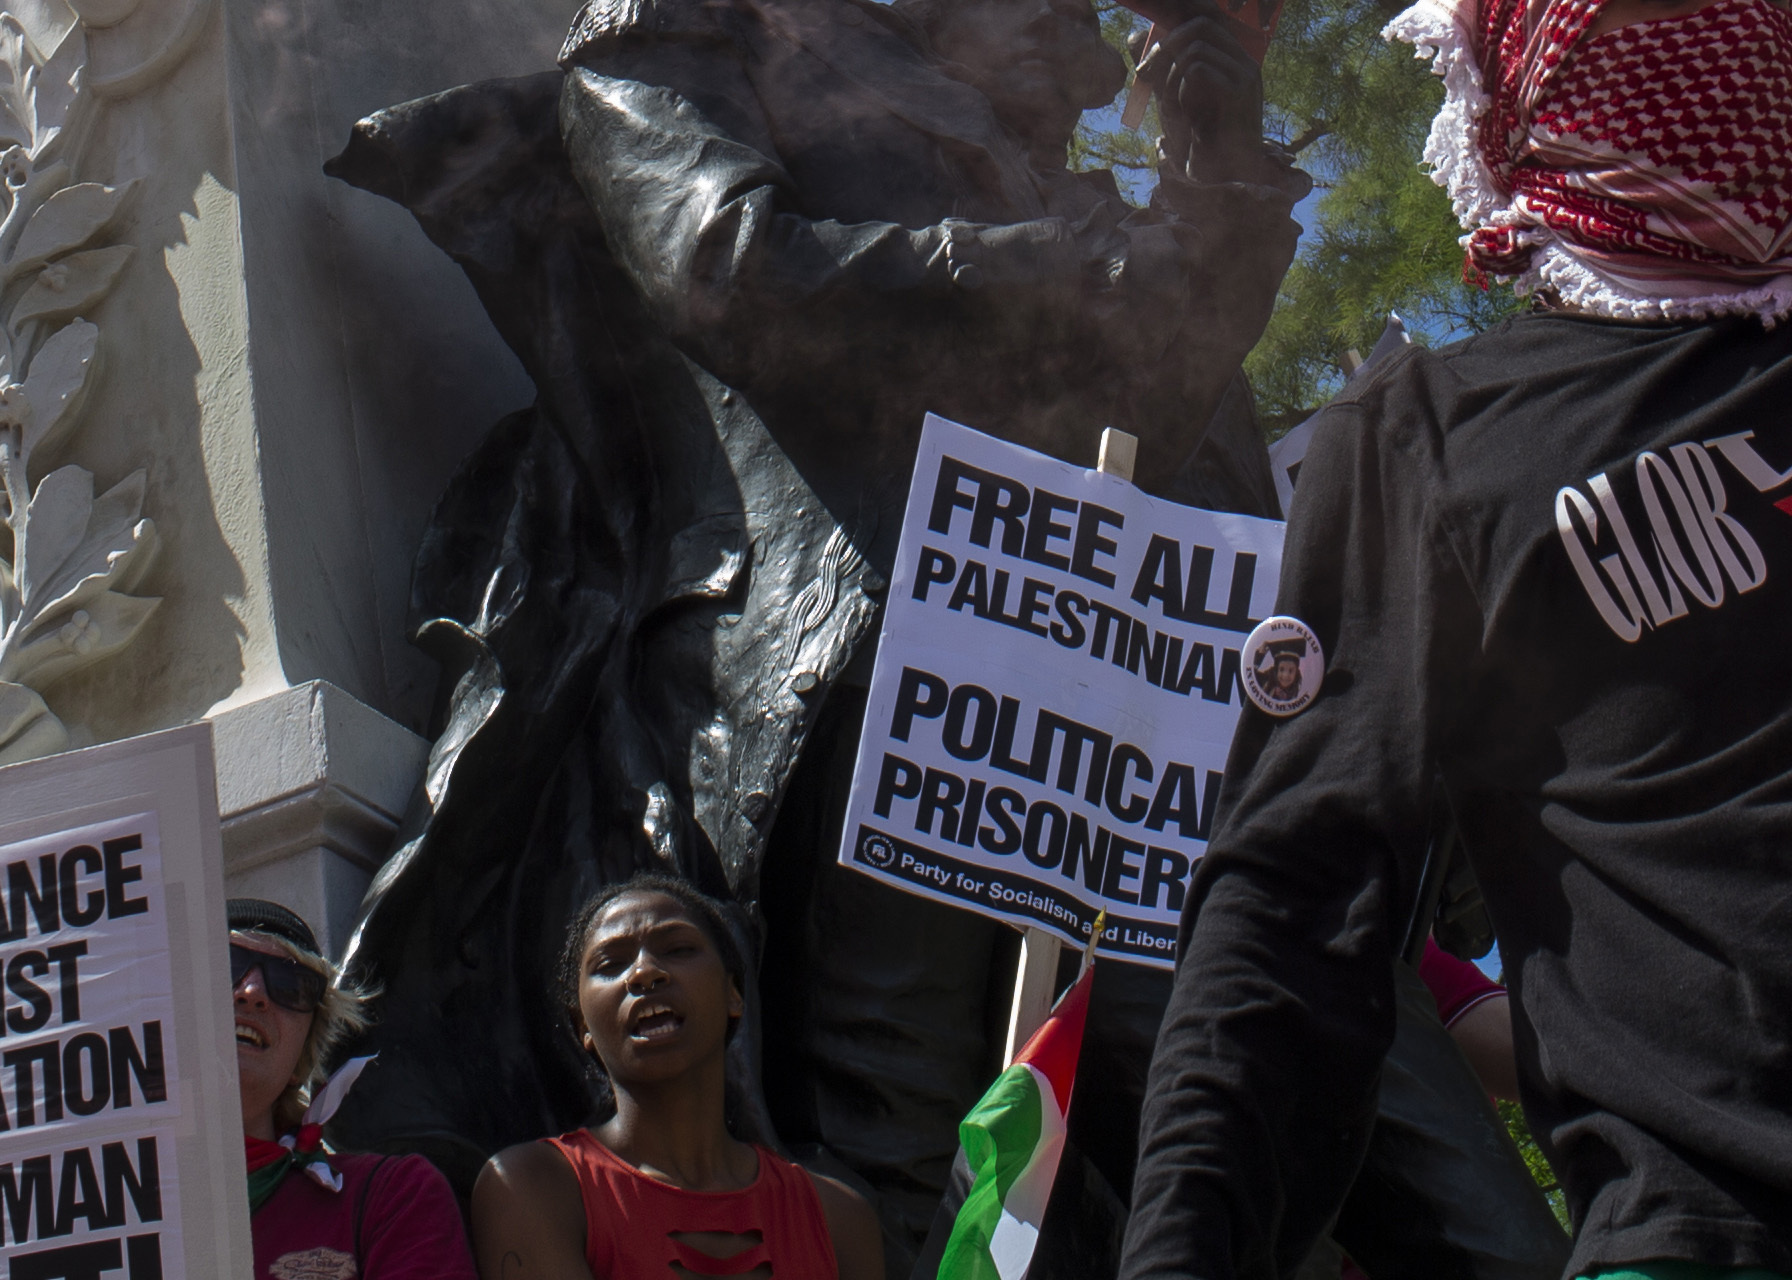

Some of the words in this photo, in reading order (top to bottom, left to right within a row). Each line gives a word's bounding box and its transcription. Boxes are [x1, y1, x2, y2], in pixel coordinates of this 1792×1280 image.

[927, 455, 1124, 587] FREE
[1131, 532, 1269, 634] ALL
[873, 753, 1201, 910] PRISONER
[901, 853, 951, 885] Party
[956, 873, 984, 893] for
[989, 883, 1078, 927] Socialism
[1124, 923, 1176, 951] Liber
